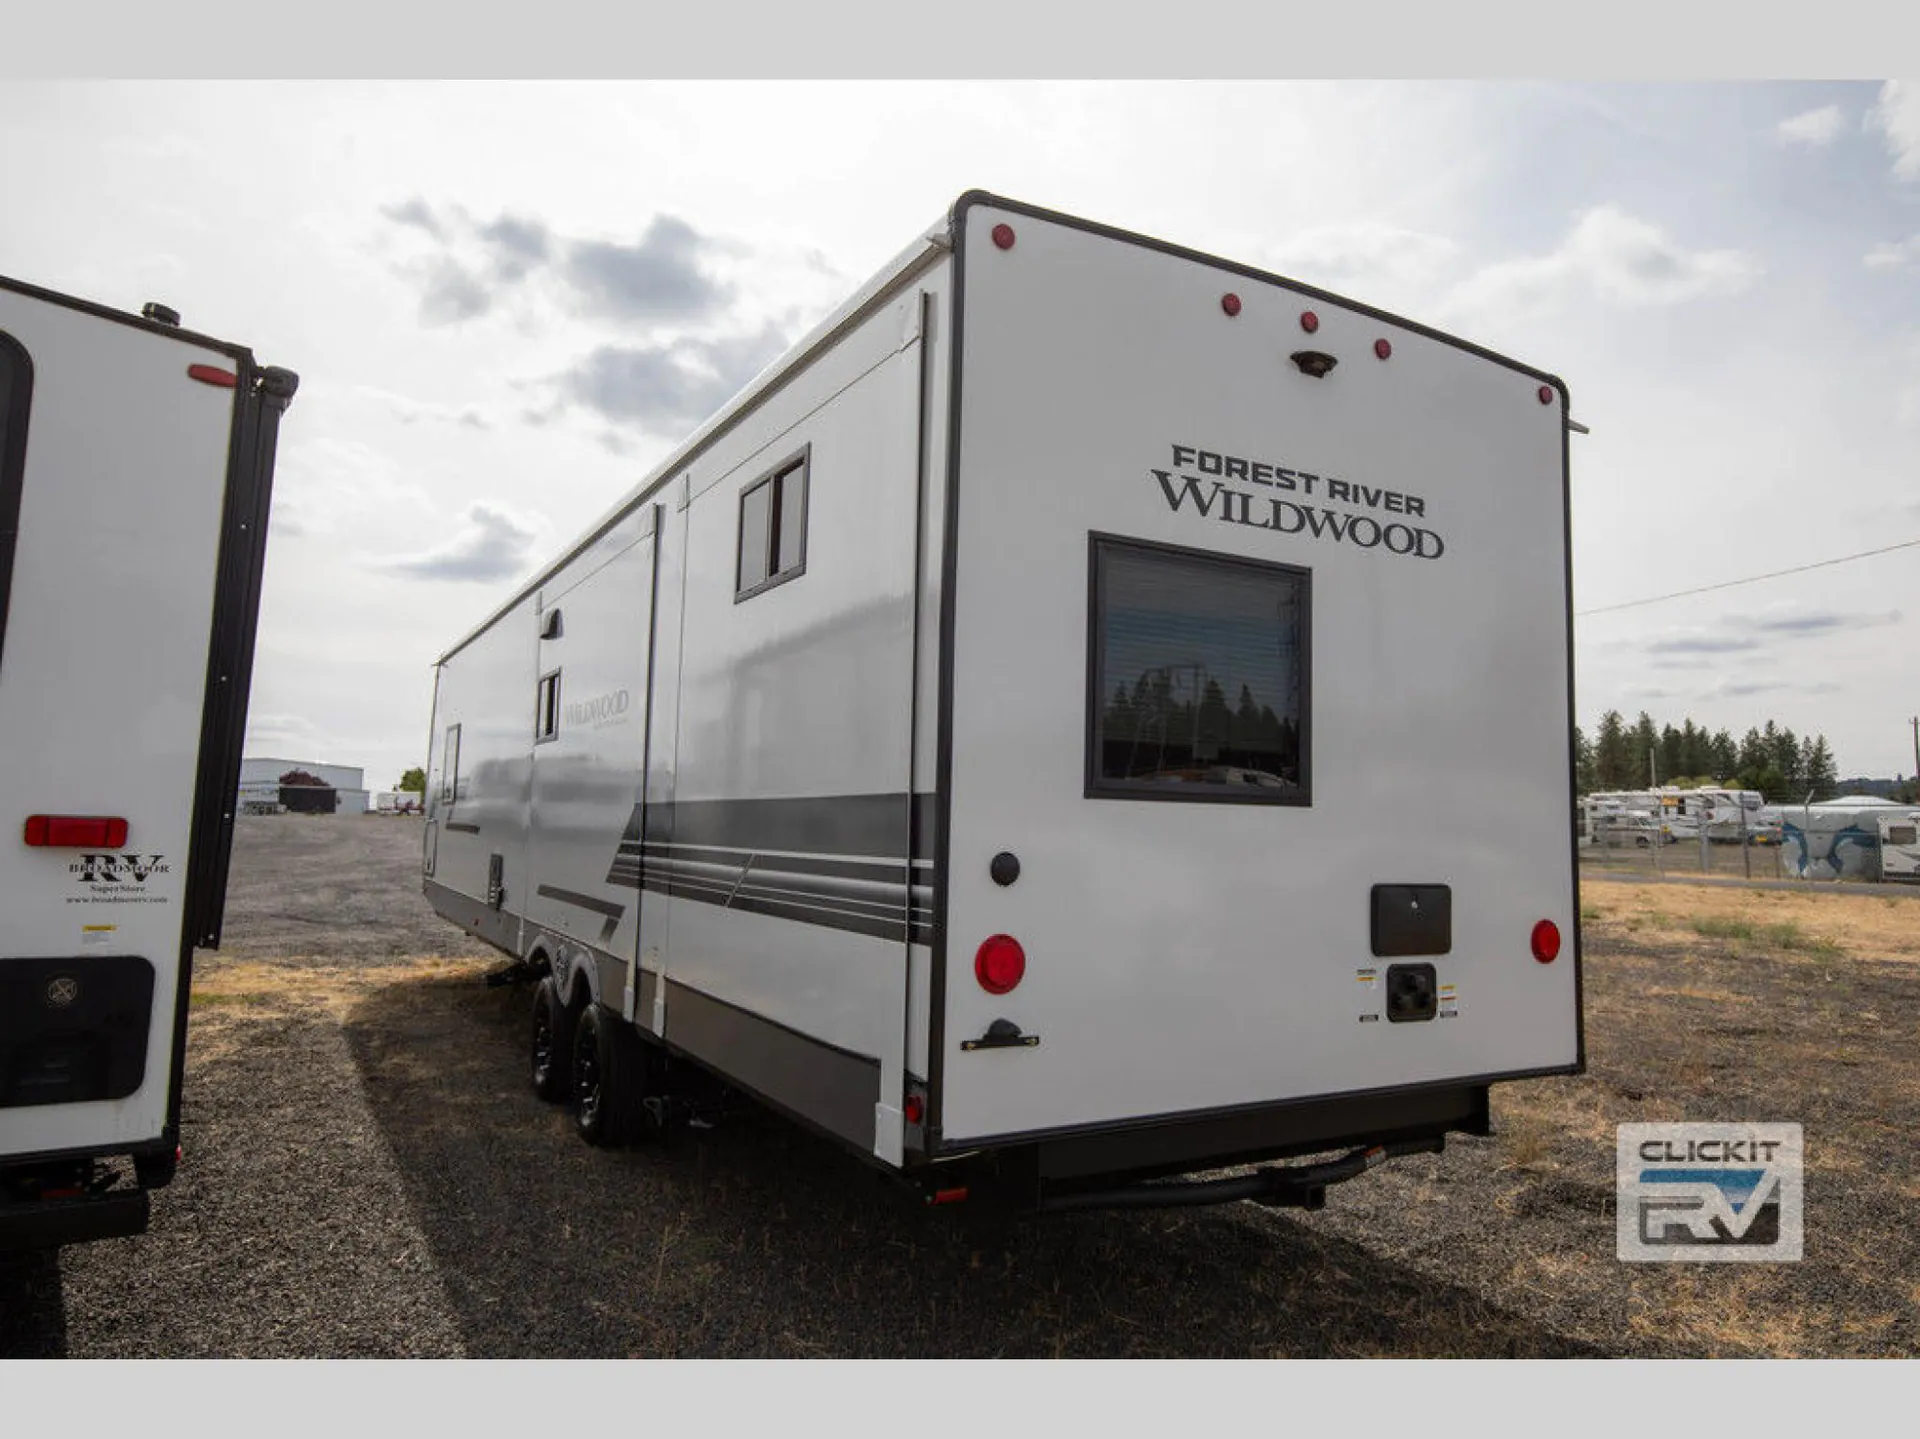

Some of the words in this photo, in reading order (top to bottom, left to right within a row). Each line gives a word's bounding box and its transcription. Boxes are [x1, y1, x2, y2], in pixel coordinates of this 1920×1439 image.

[1150, 469, 1445, 560] WILDWOOD
[1171, 444, 1319, 494] FOREST
[1328, 478, 1425, 517] RIVER
[78, 854, 165, 882] RV
